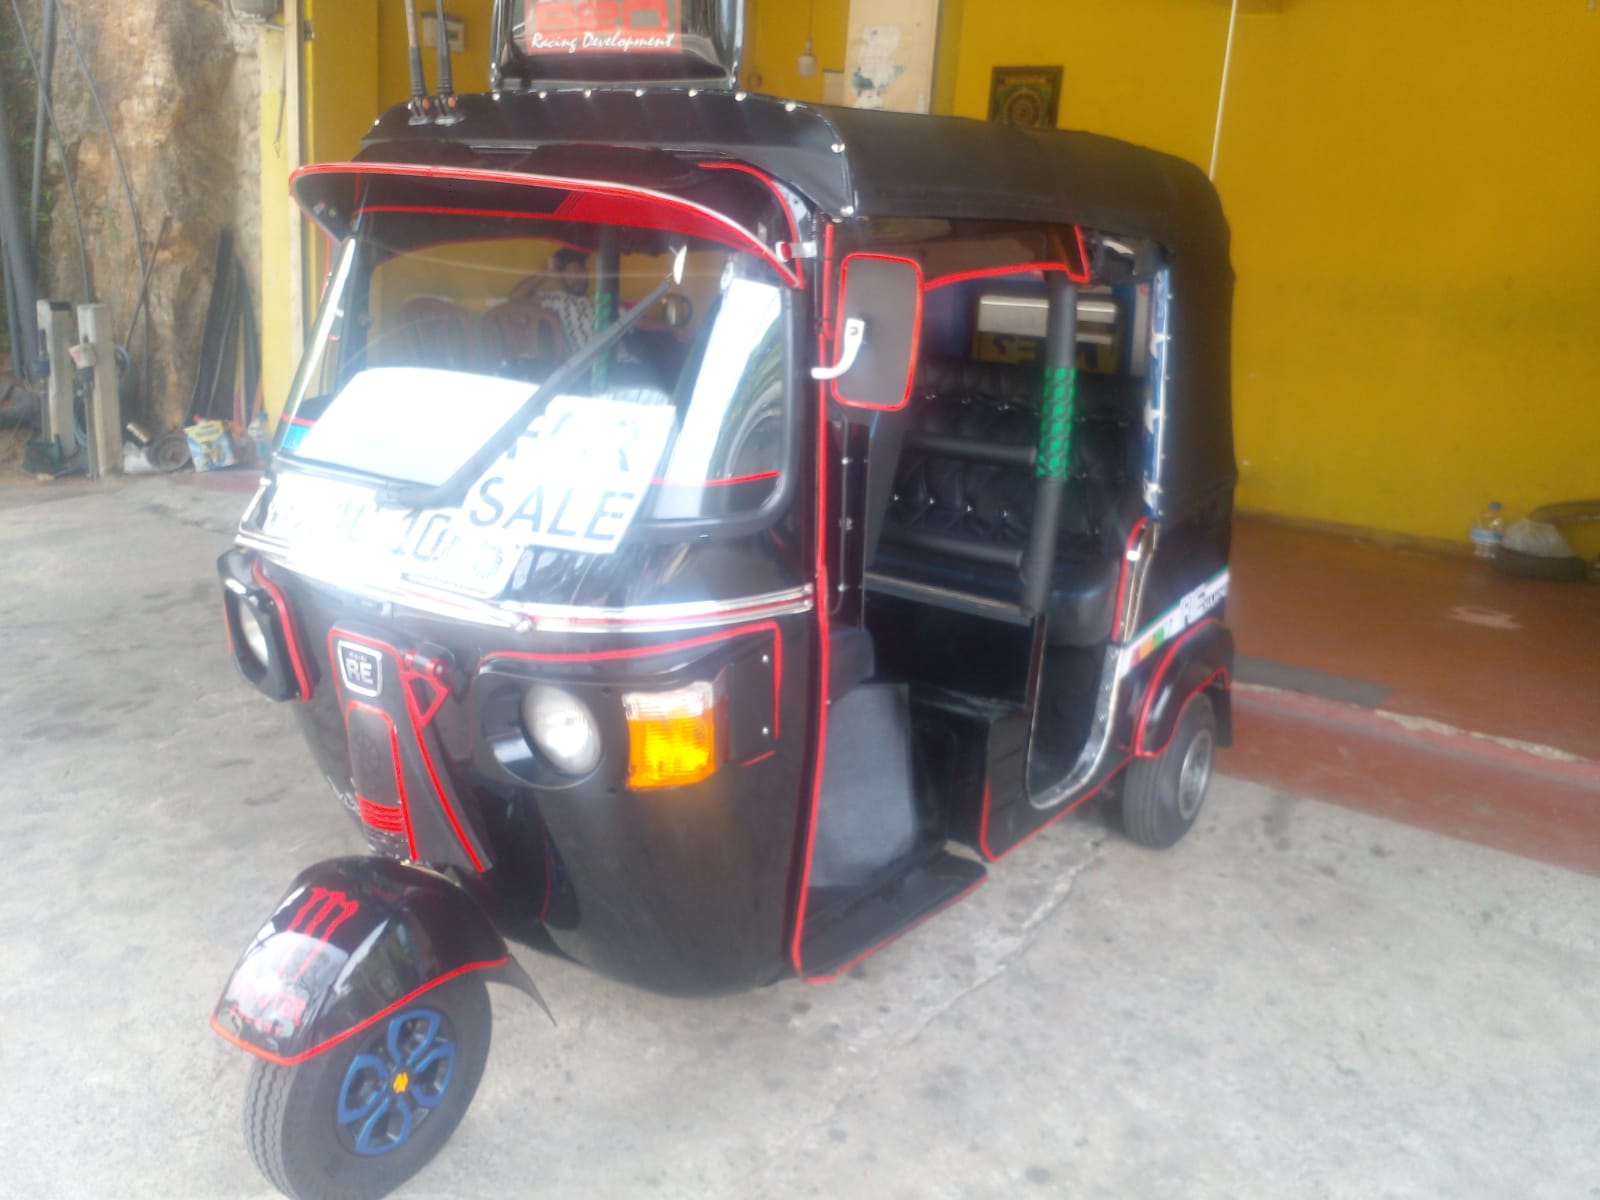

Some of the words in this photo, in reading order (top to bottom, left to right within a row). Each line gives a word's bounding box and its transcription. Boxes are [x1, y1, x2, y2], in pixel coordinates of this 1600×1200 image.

[531, 32, 578, 54] Racing
[582, 31, 677, 52] Development
[470, 476, 635, 541] SALE
[345, 658, 373, 685] RE
